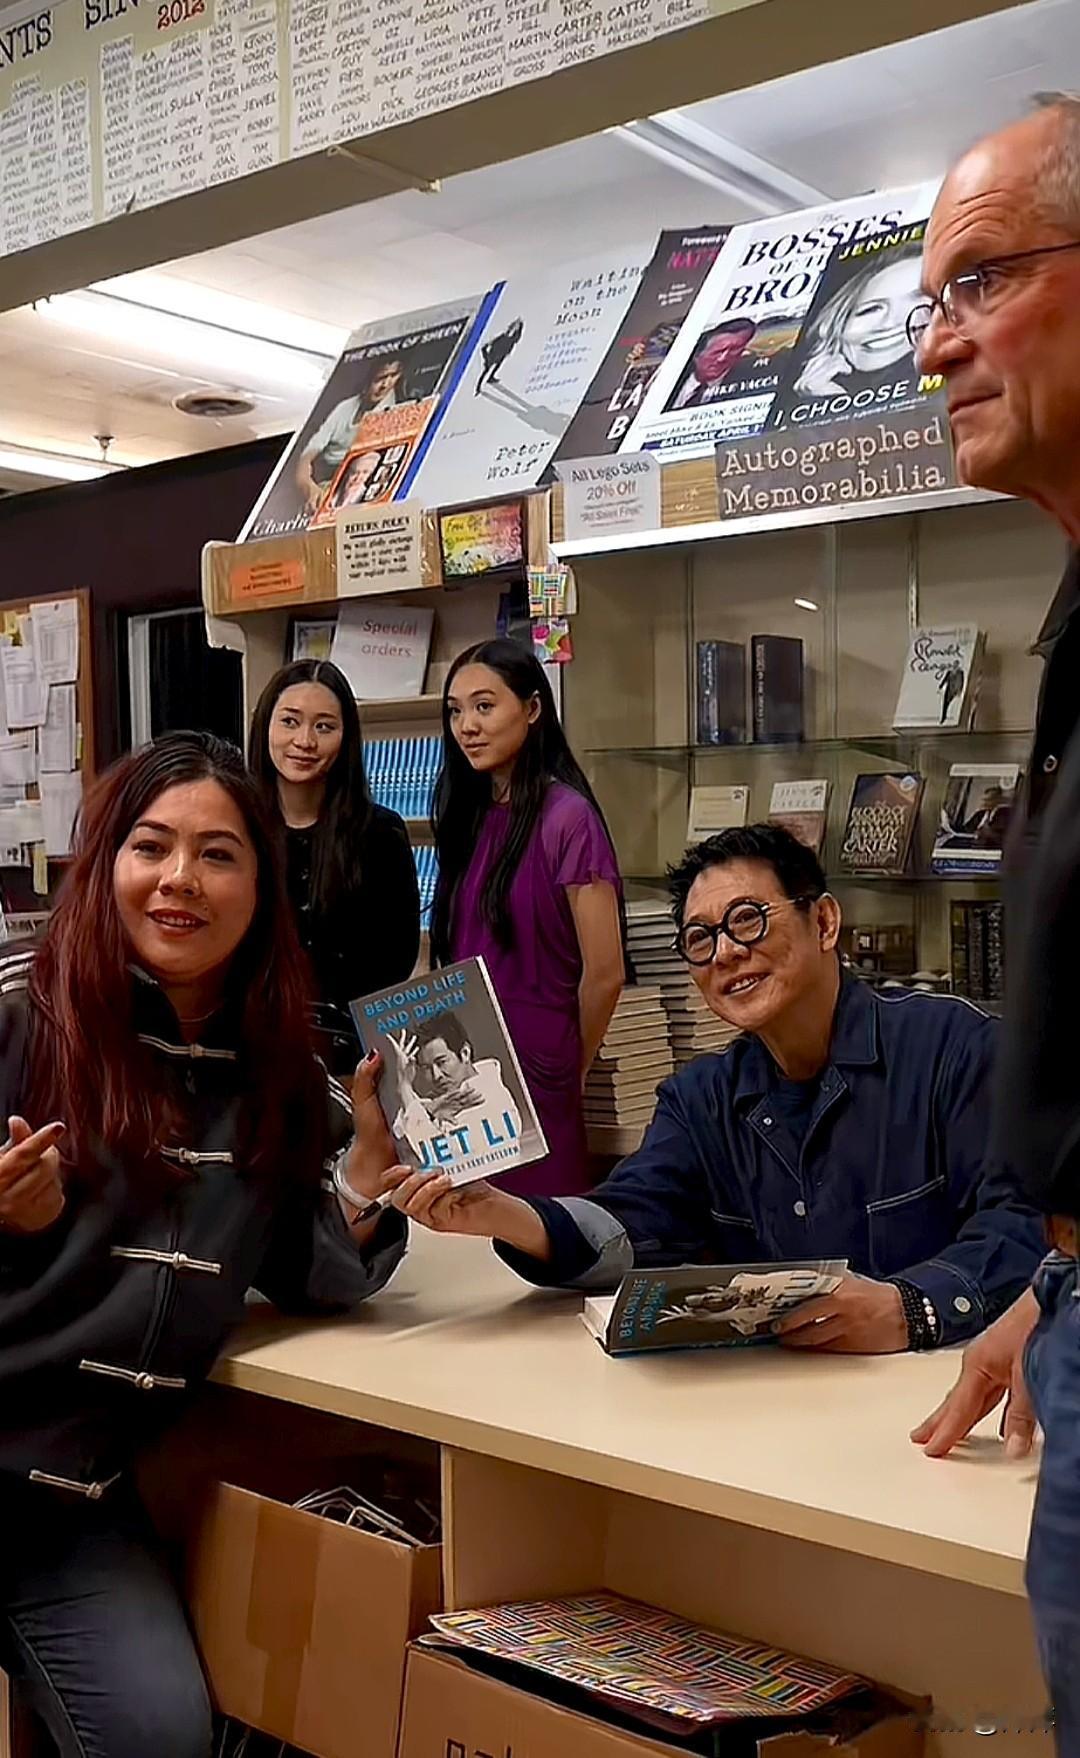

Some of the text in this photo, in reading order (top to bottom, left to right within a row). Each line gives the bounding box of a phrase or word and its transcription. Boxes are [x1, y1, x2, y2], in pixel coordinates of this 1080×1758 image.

[740, 210, 903, 268] BOSSES
[838, 227, 925, 260] JENNIE
[563, 285, 627, 309] on the
[554, 307, 602, 326] Moon
[344, 323, 463, 363] THE BOOK OF SHEEN
[704, 382, 738, 398] MIKE
[689, 409, 725, 421] BOOK
[774, 410, 784, 427] I
[791, 380, 910, 422] CHOOSE
[495, 440, 551, 461] Peter
[721, 419, 944, 479] Autographed
[722, 464, 946, 515] Memorabilia
[253, 513, 310, 536] Charlie
[345, 516, 410, 533] RETURN POLICY
[363, 618, 418, 637] Special
[361, 643, 412, 658] orders
[844, 838, 897, 853] CARTER
[363, 969, 467, 1018] BEYOND LIFE
[375, 989, 467, 1033] AND DEATH
[418, 1124, 471, 1169] JET
[481, 1111, 518, 1147] LI
